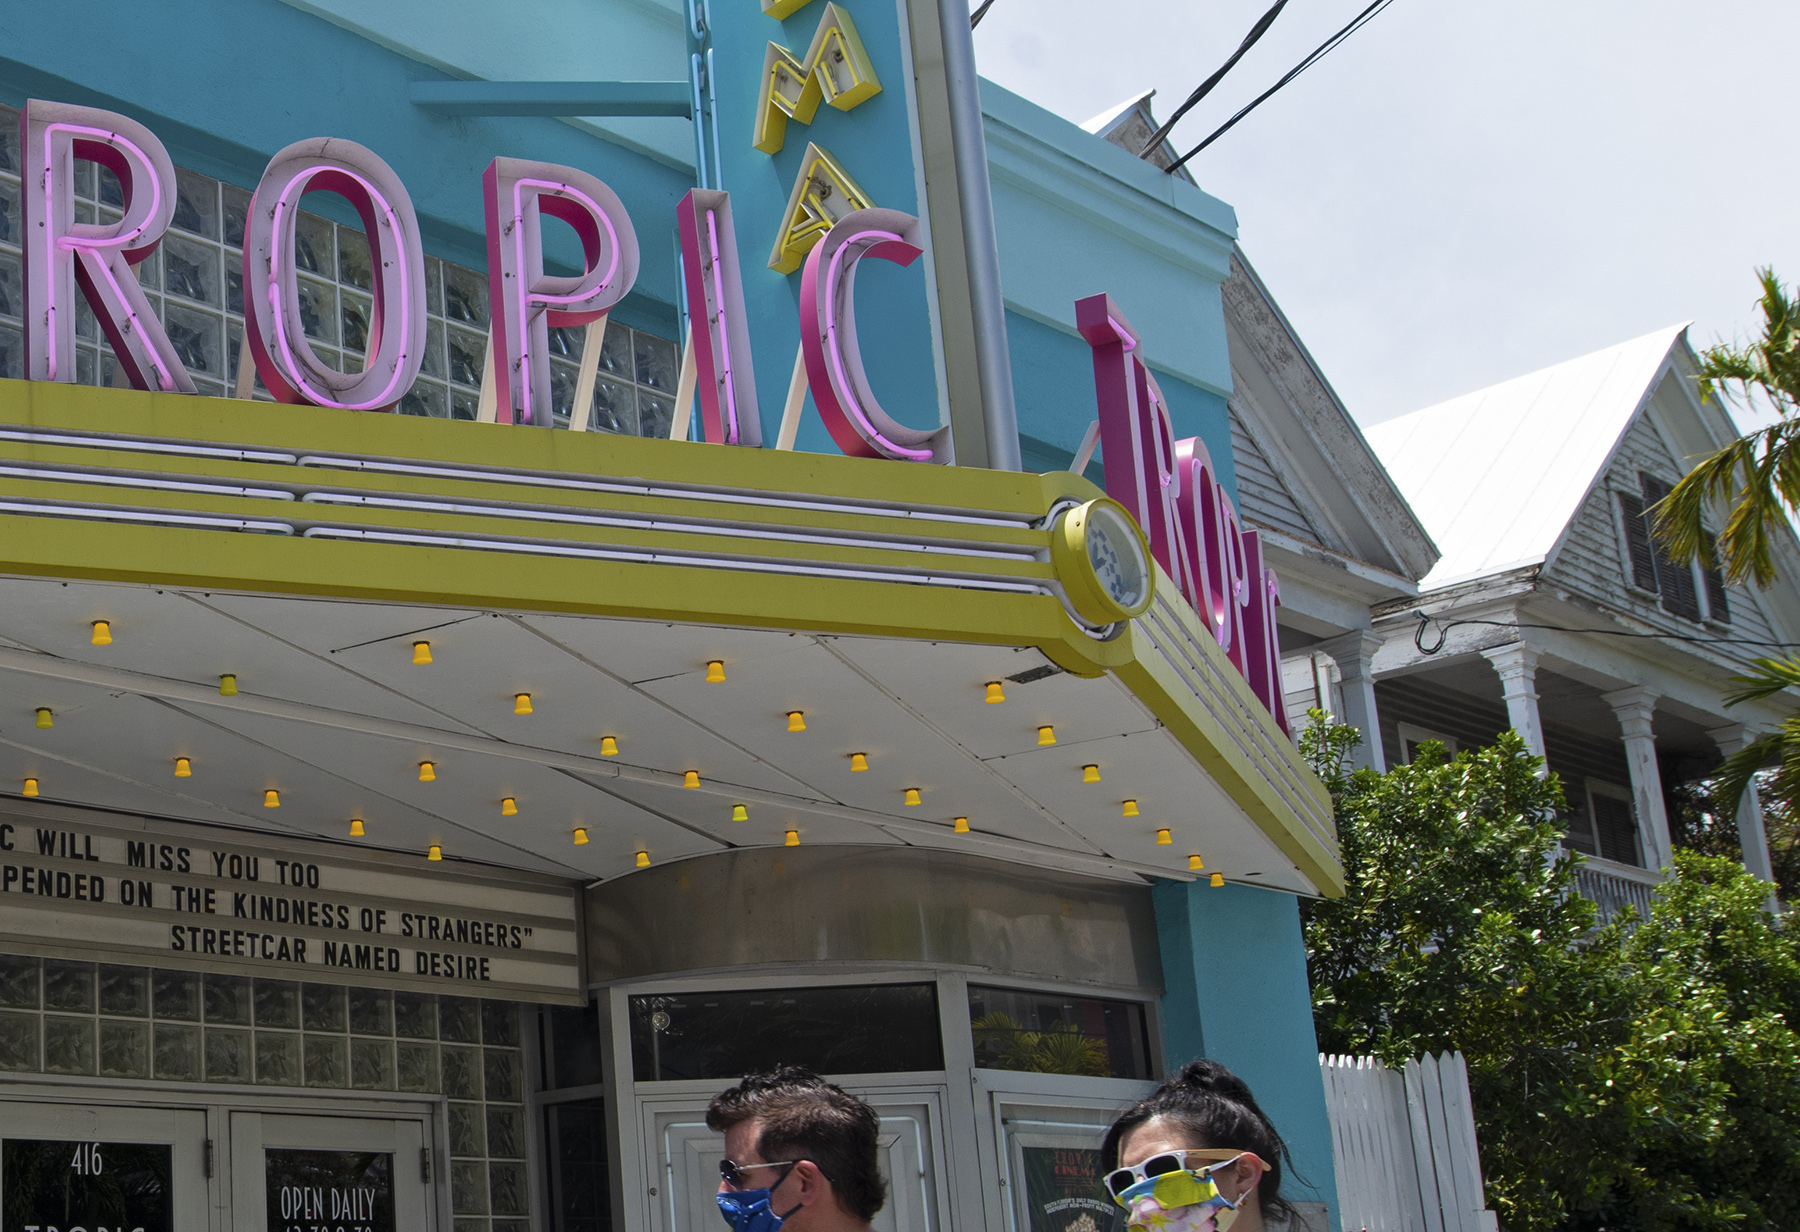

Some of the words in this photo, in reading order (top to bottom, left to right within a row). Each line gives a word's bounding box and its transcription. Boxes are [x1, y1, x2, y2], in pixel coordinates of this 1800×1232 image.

[37, 828, 99, 862] WILL
[127, 840, 191, 873] MISS
[212, 851, 259, 882] YOU
[276, 860, 320, 889] TOO
[120, 879, 153, 909] ON
[172, 885, 215, 914] THE
[233, 892, 349, 931] KINDNESS
[360, 907, 387, 934] OF
[171, 925, 306, 963] STREETCAR
[324, 941, 400, 973] NAMED
[416, 951, 490, 981] DESIRE
[71, 1142, 102, 1176] 416
[1054, 1165, 1096, 1176] CINEMA
[281, 1186, 323, 1220] OPEN
[331, 1187, 375, 1221] DAILY
